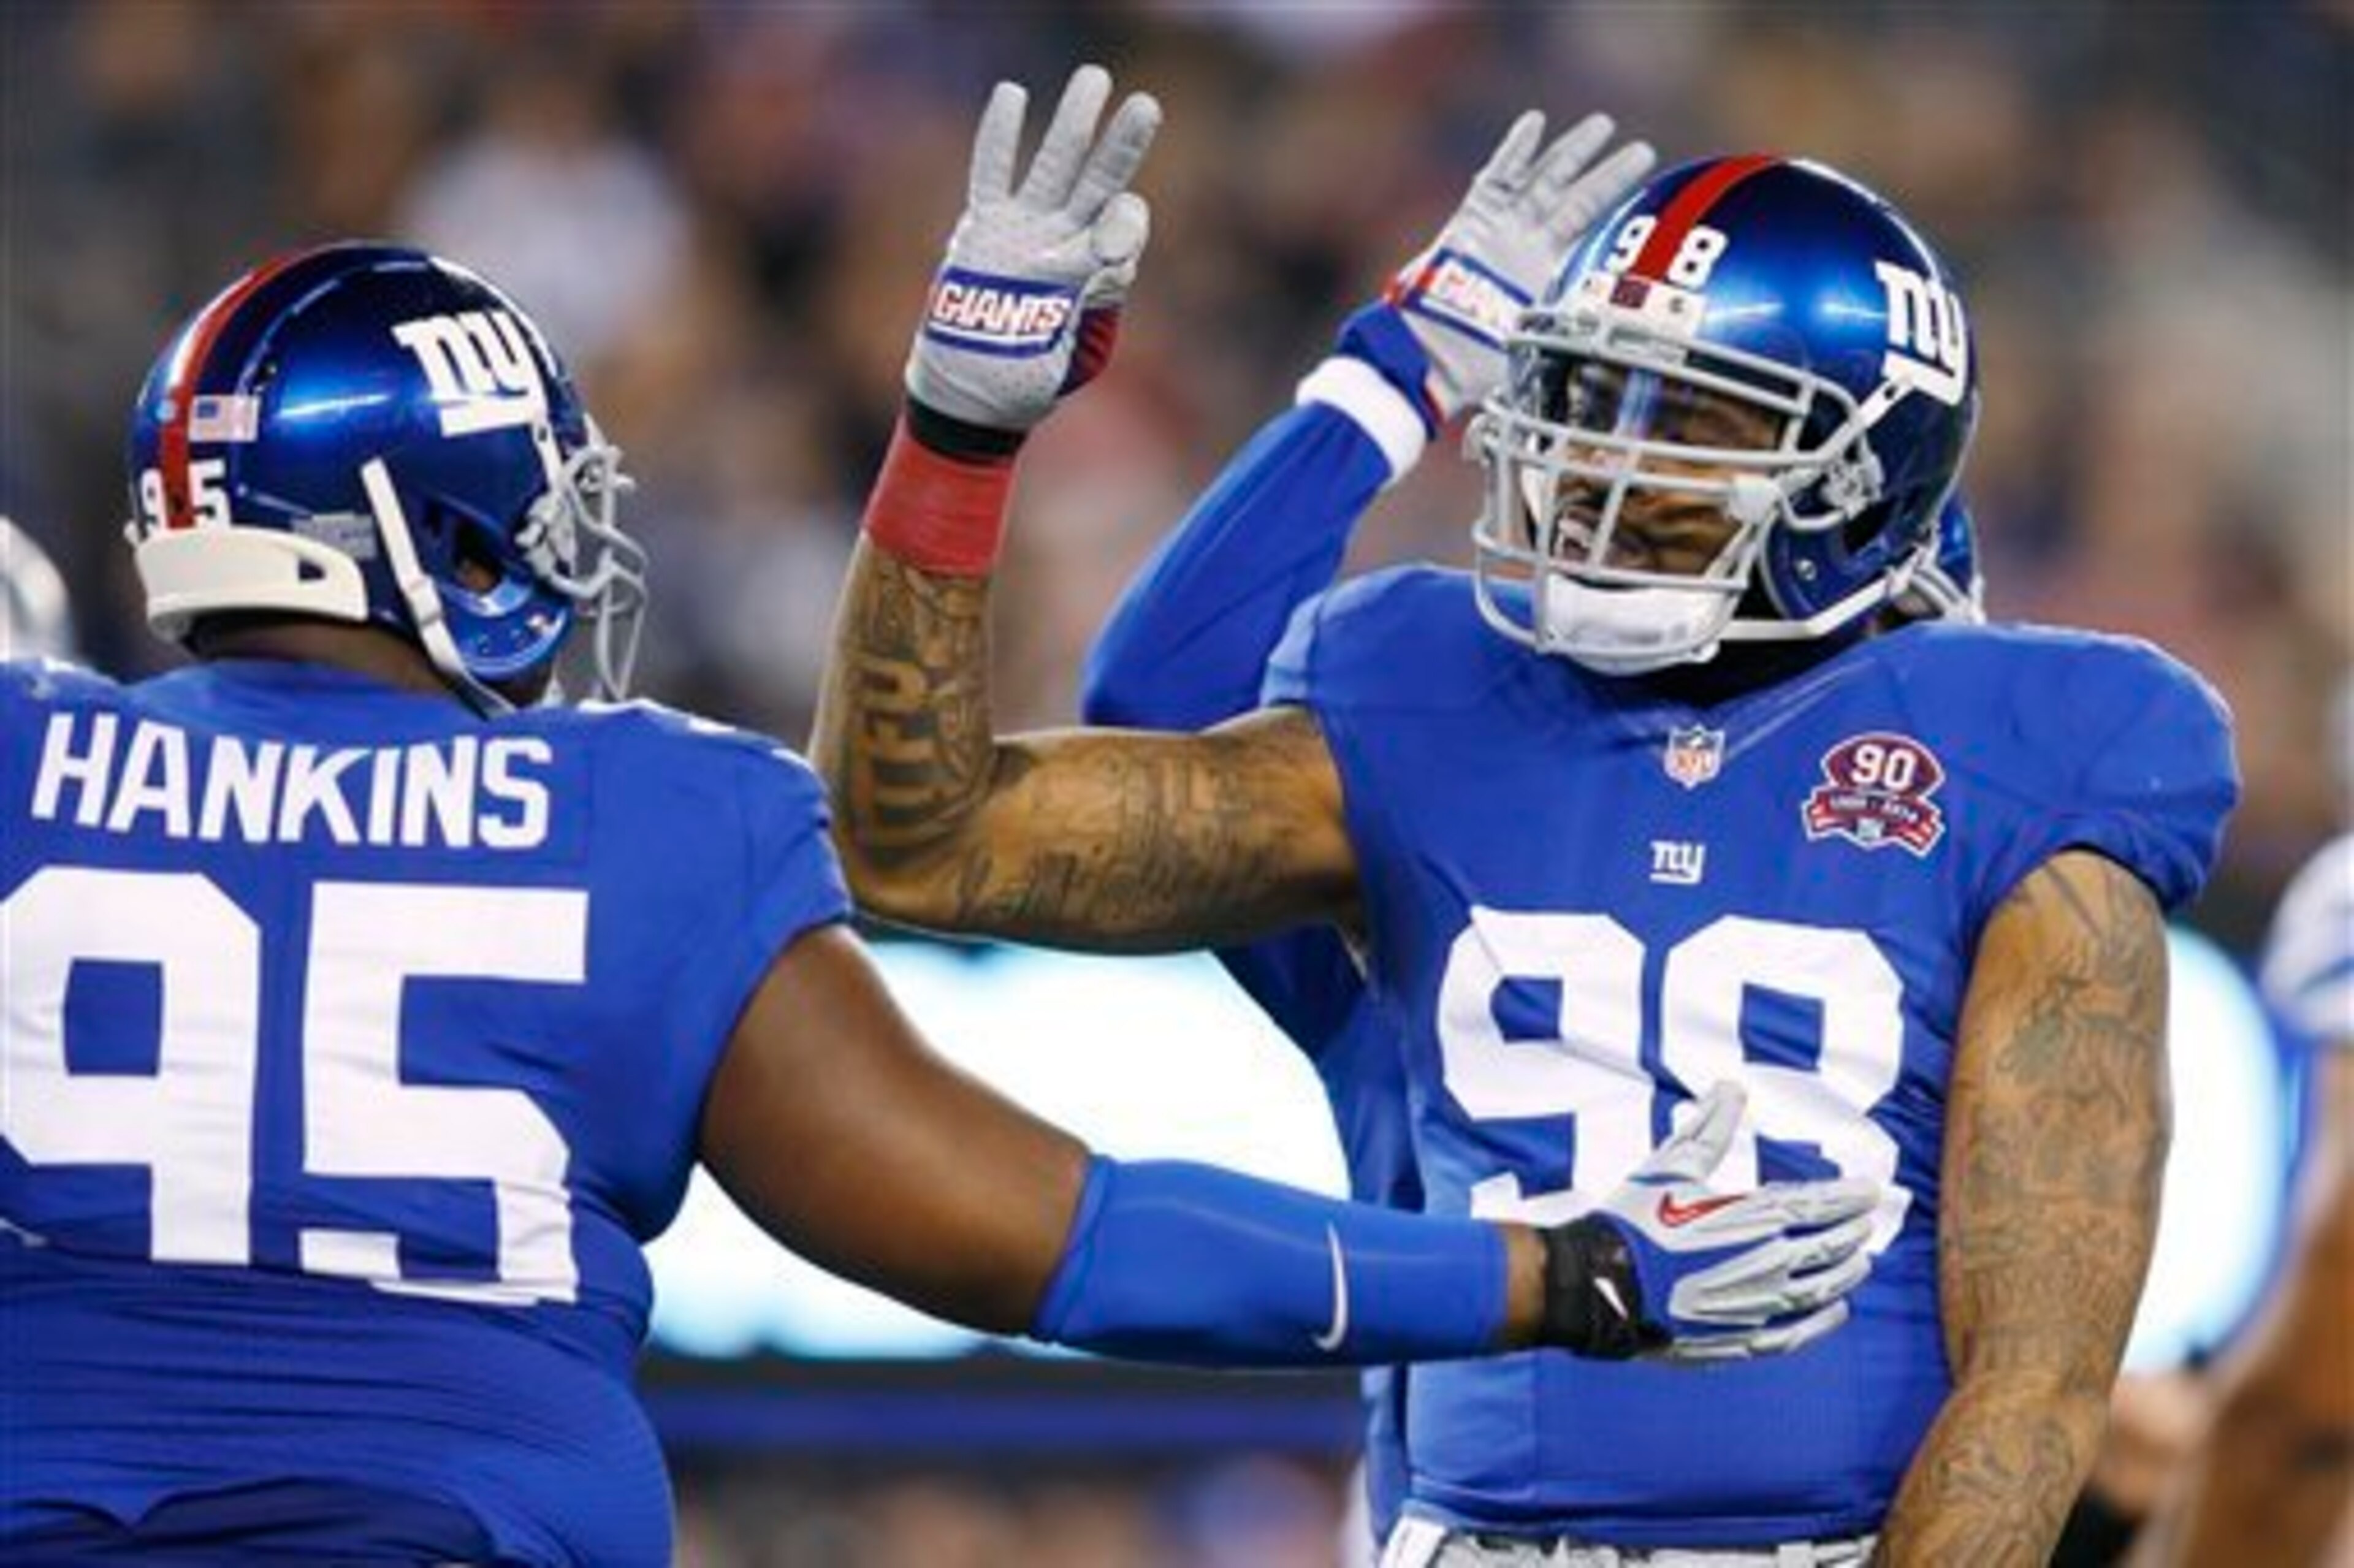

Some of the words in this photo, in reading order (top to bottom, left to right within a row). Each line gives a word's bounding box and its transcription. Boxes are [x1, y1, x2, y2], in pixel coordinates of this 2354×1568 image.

[1604, 215, 1728, 289] 98
[932, 281, 1072, 332] GIANTS
[141, 459, 230, 535] 95
[31, 713, 552, 848] HANKINS
[1851, 744, 1916, 791] 90
[0, 865, 588, 1304] 95
[1438, 904, 1913, 1255] 98
